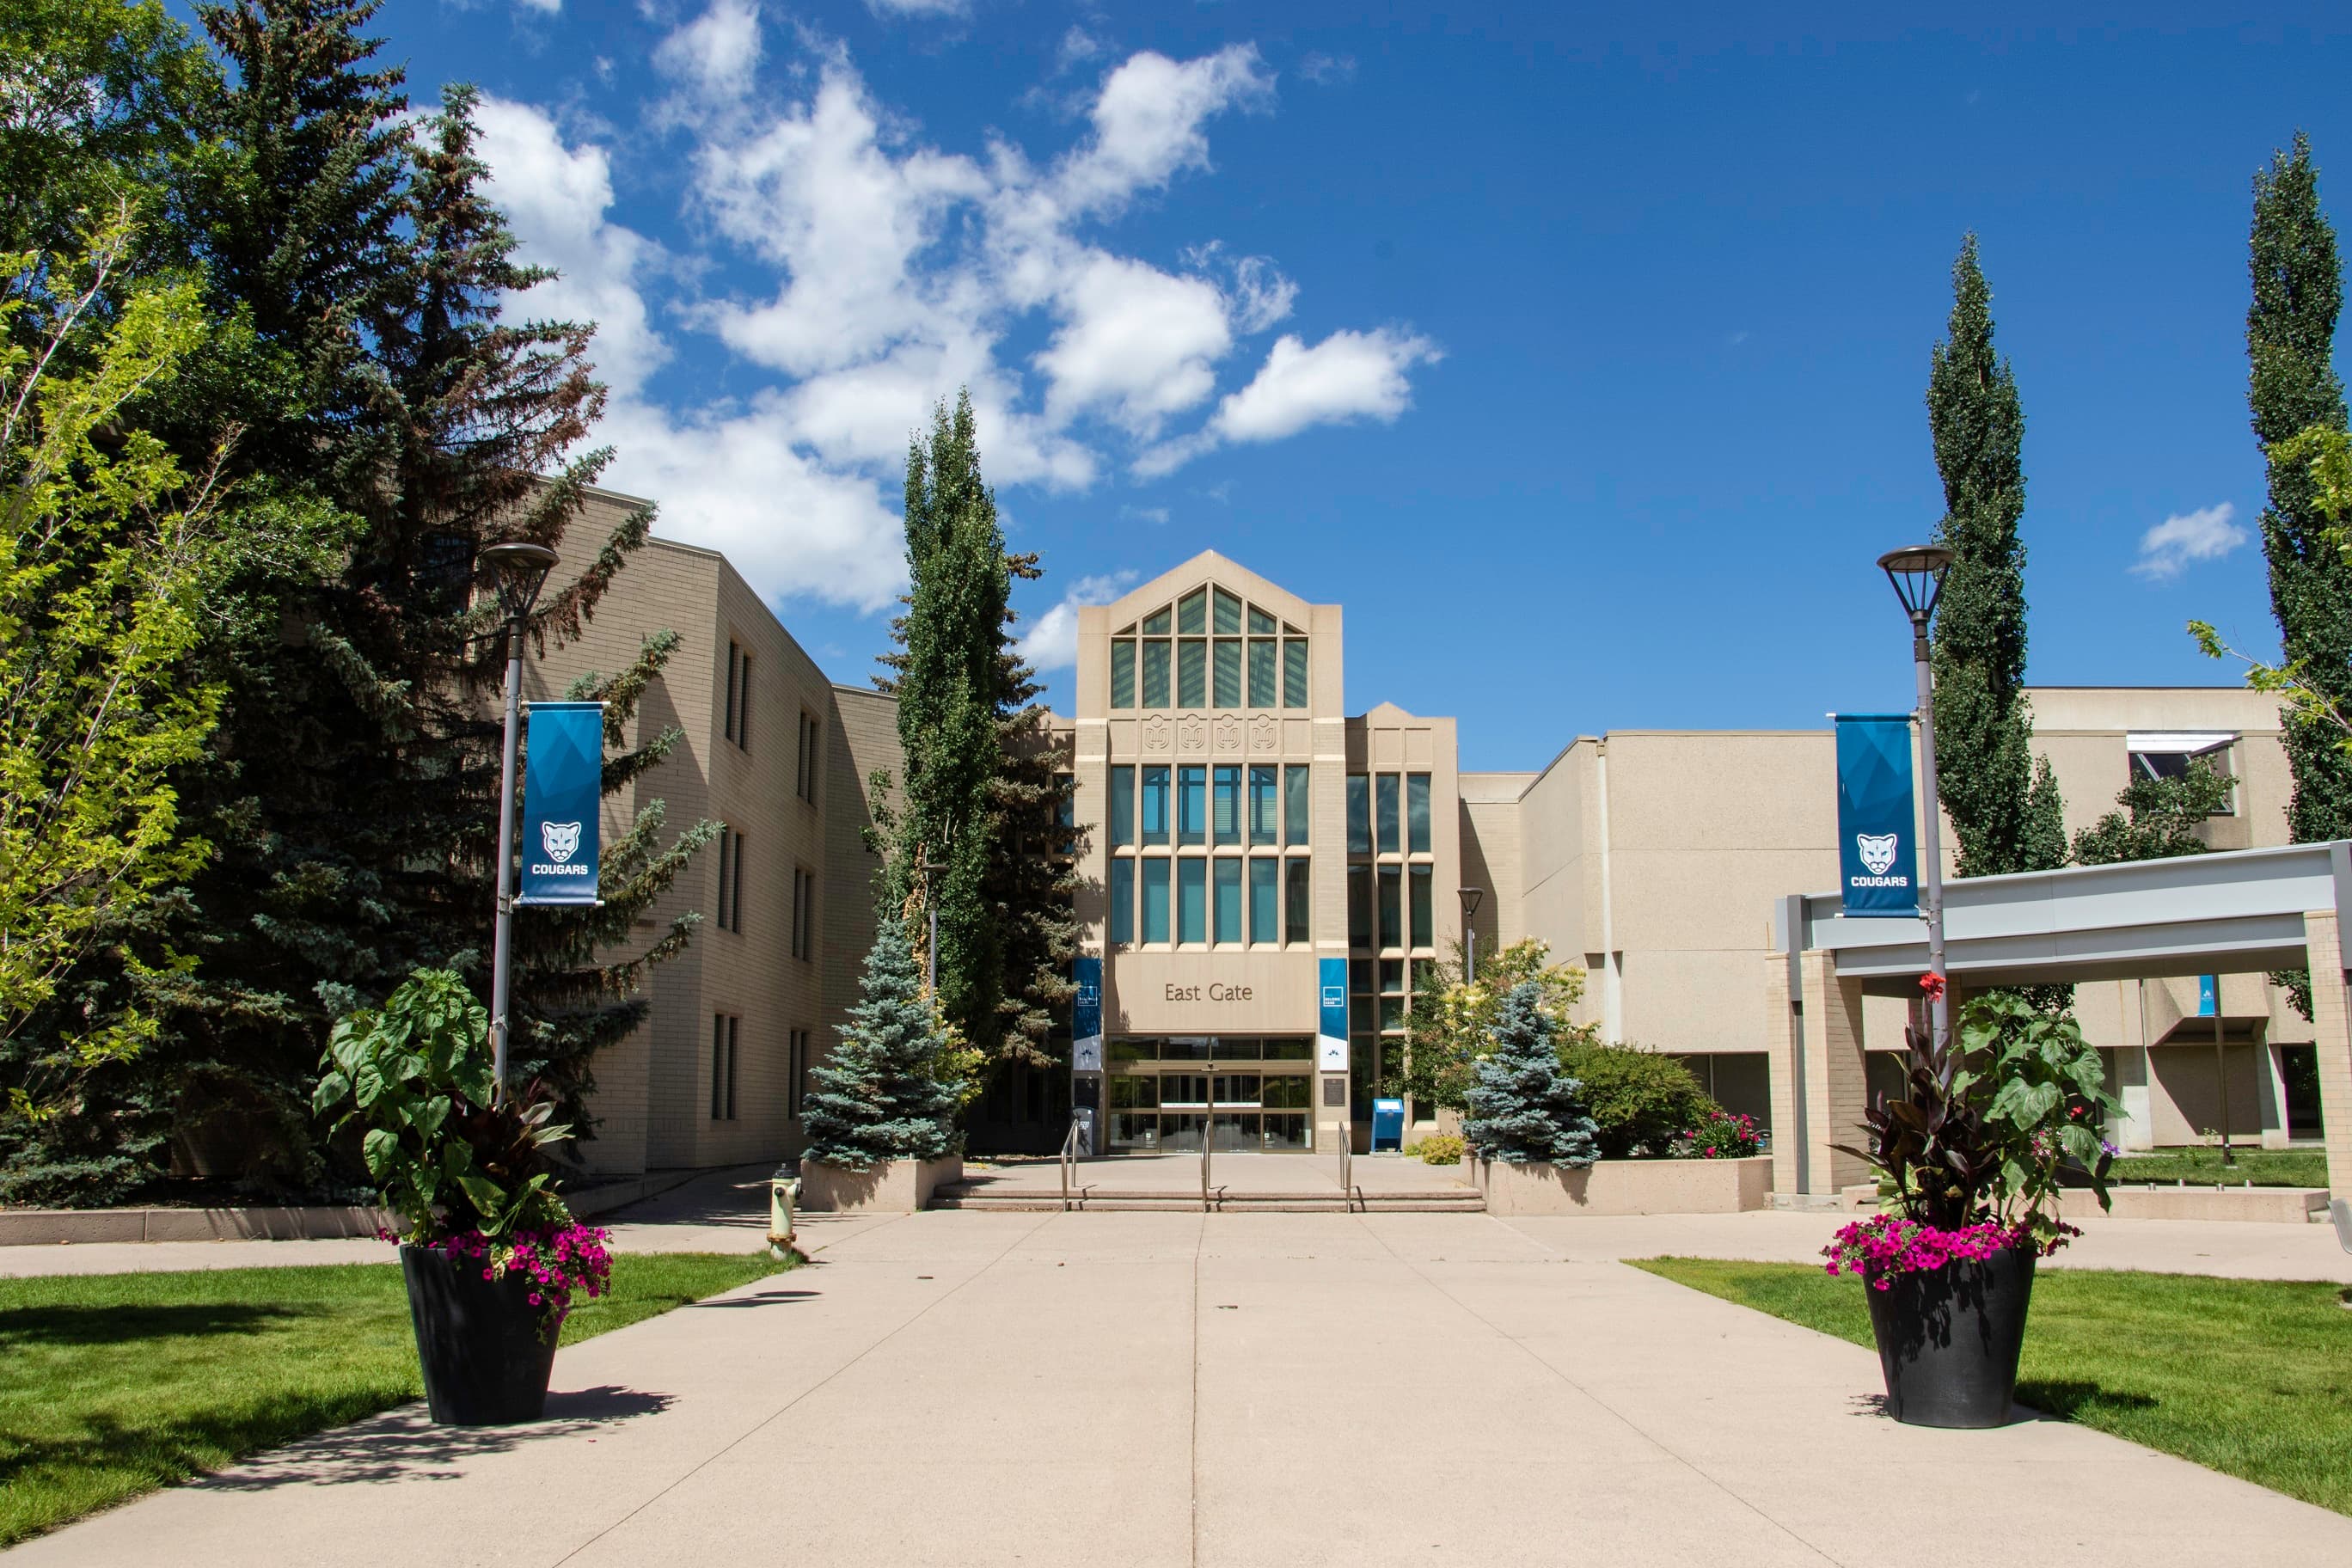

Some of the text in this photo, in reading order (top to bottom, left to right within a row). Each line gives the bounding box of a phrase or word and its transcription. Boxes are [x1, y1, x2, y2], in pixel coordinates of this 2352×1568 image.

[532, 864, 588, 875] COUGARS
[1851, 876, 1908, 887] COUGARS
[1166, 983, 1253, 1001] East Gate
